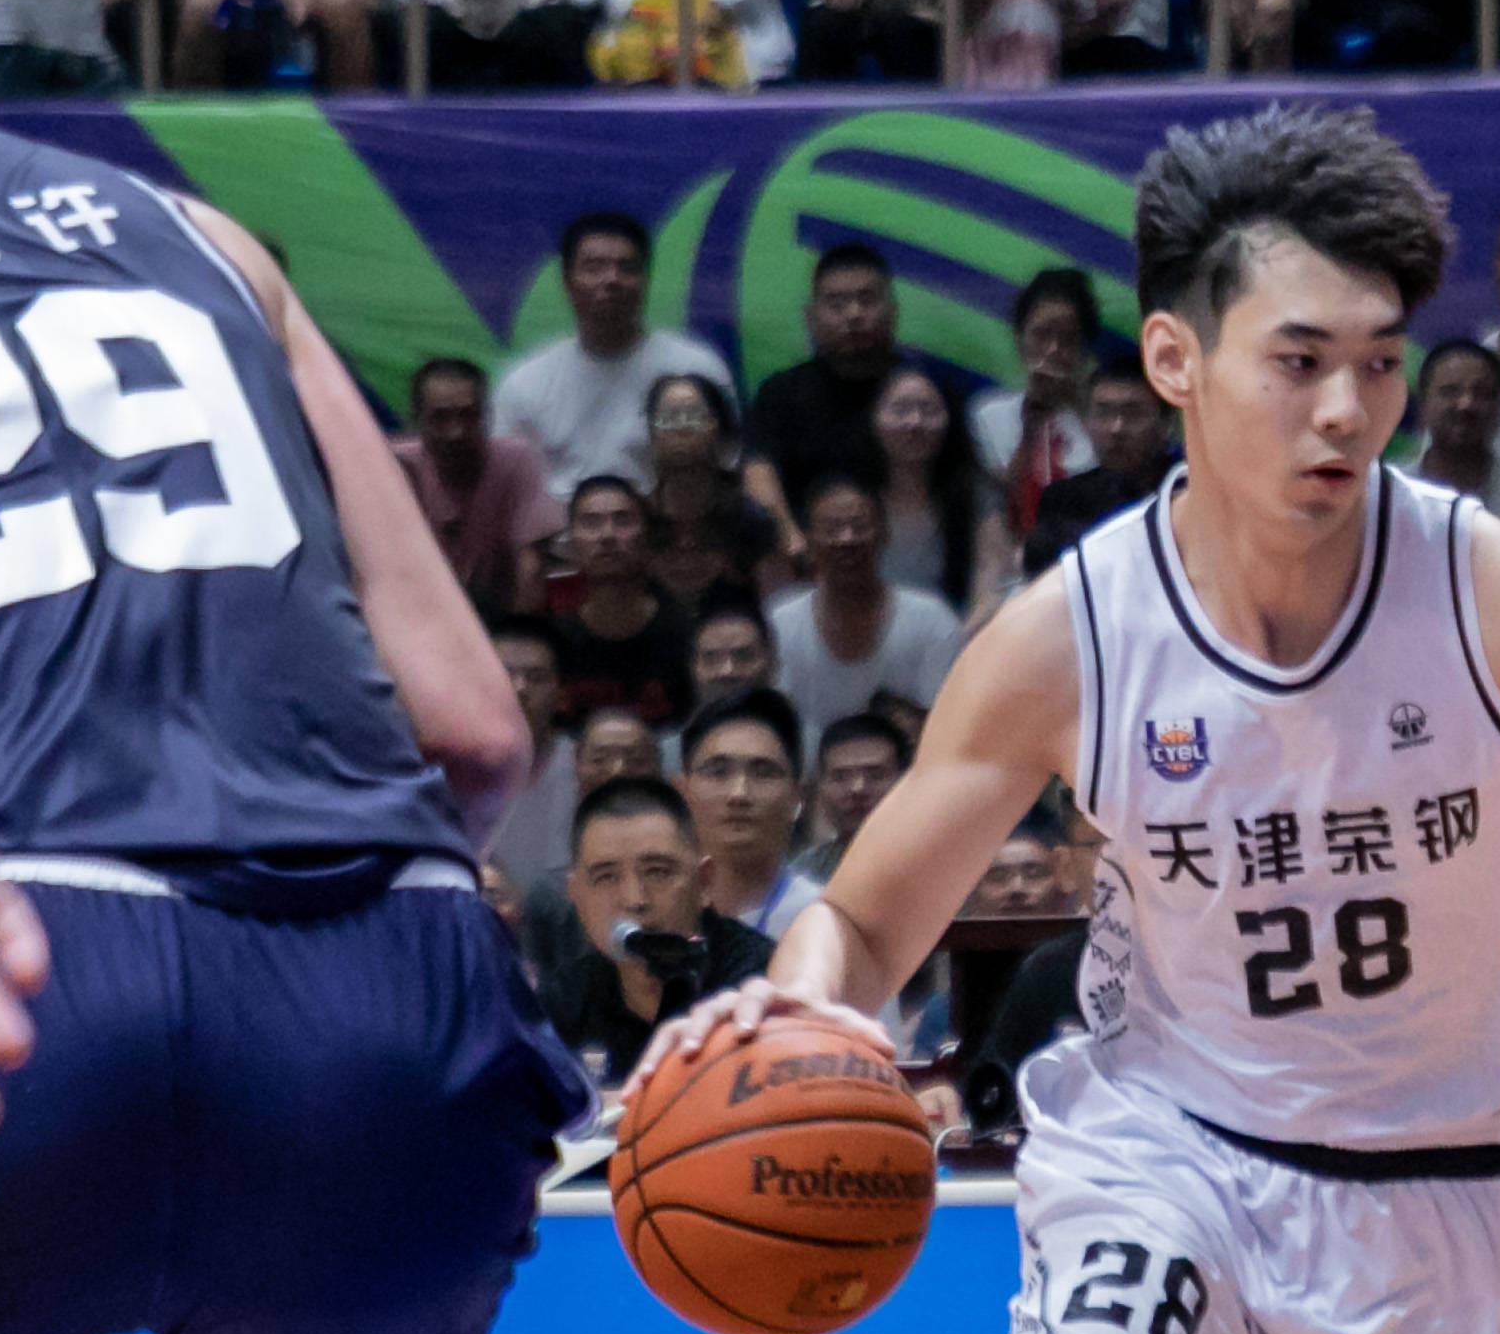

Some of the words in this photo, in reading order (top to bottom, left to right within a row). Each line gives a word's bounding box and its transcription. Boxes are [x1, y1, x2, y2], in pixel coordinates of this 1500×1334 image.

[1151, 742, 1206, 764] CYBL
[1145, 786, 1481, 889] 天津荣钢
[1235, 896, 1412, 1020] 28
